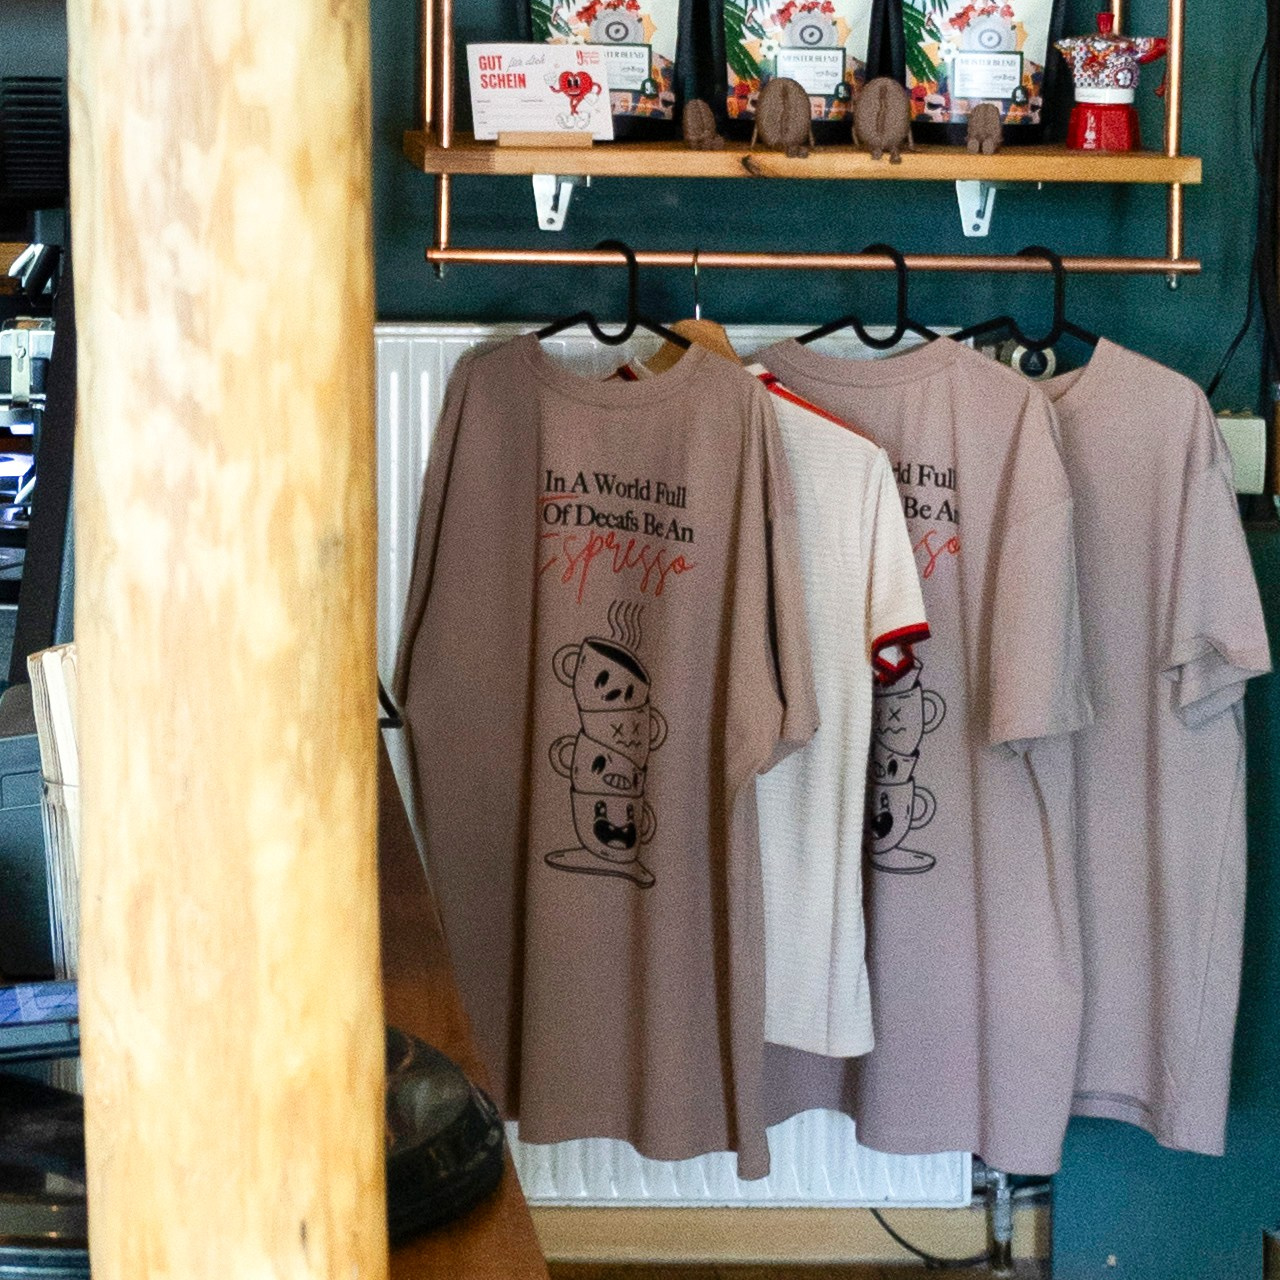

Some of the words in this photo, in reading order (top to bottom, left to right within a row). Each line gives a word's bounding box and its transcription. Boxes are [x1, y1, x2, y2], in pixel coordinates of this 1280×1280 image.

[478, 55, 502, 71] GUT
[480, 73, 526, 89] SCHEIN
[544, 470, 566, 493] In
[571, 471, 589, 494] A
[594, 473, 651, 501] World
[655, 482, 687, 508] Full
[918, 464, 957, 491] Full
[904, 495, 932, 520] Be
[543, 503, 573, 526] Of
[575, 504, 640, 532] Decafs
[643, 512, 664, 538] Be
[665, 519, 695, 543] An
